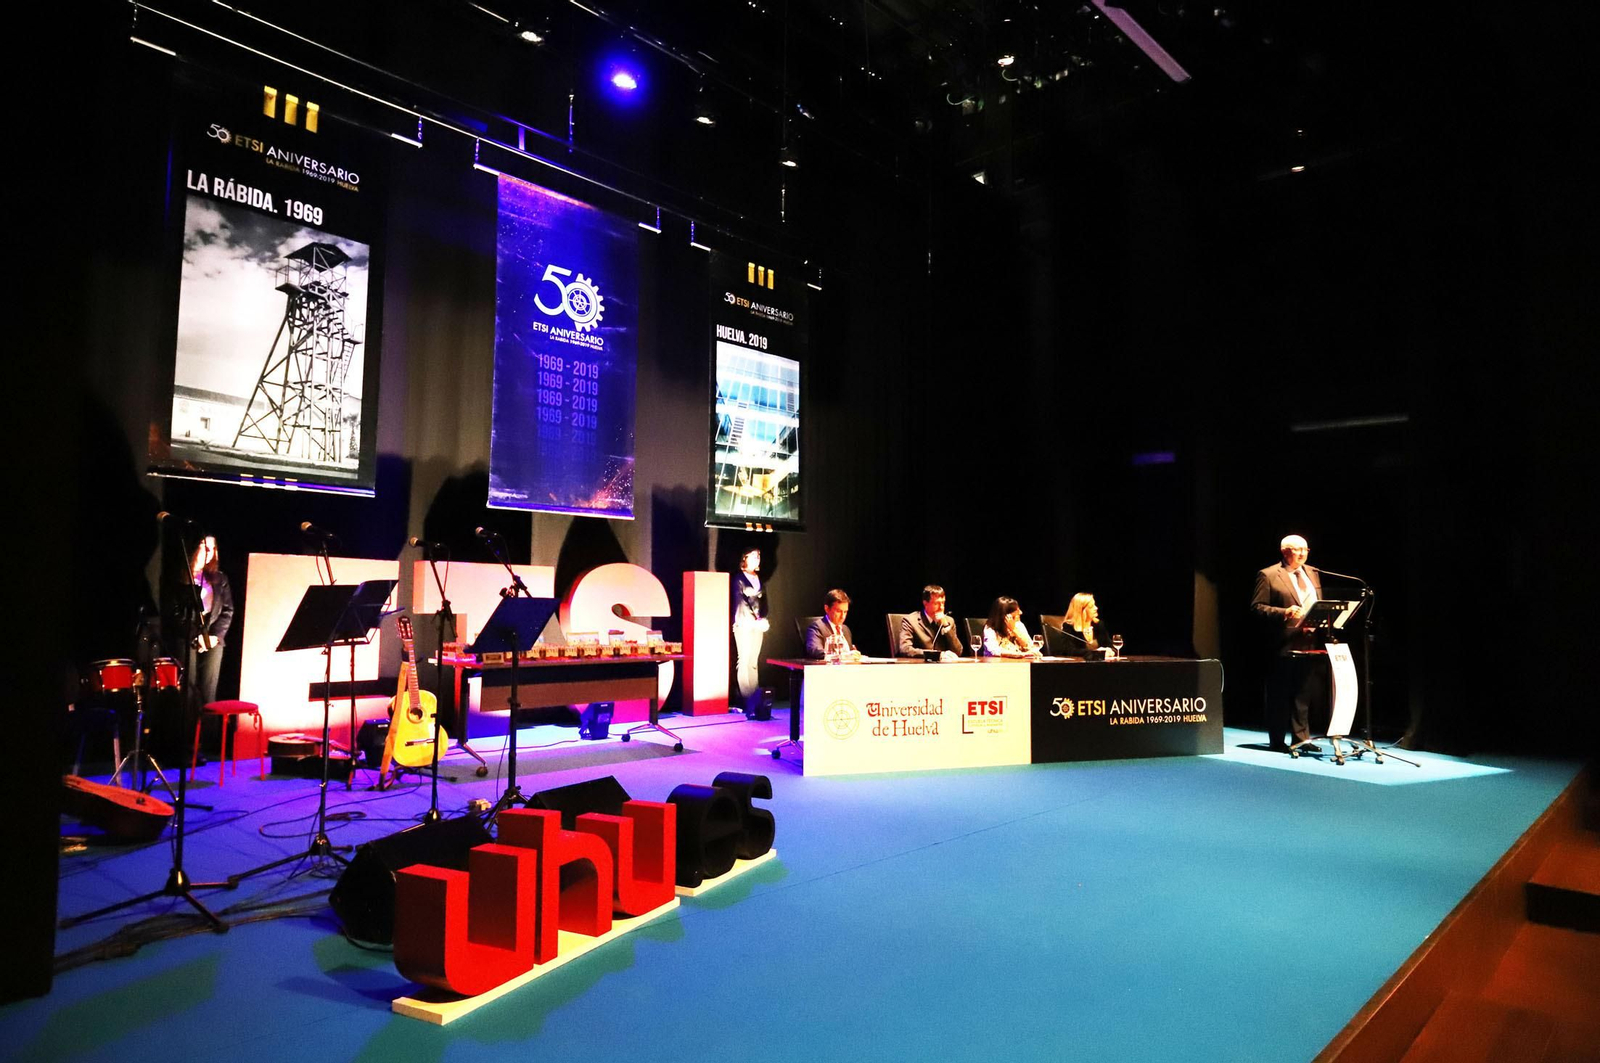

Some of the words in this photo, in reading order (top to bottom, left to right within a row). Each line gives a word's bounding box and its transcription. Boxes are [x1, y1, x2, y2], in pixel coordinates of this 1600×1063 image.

[235, 134, 264, 153] ETSI
[266, 146, 360, 184] ANIVERSARIO
[186, 169, 209, 193] LA
[213, 177, 278, 214] RÁBIDA.
[284, 199, 323, 225] 1969
[337, 180, 359, 192] HUELVA
[534, 264, 605, 332] 50
[736, 297, 750, 308] ETSI
[750, 302, 794, 321] ANIVERSARIO
[533, 321, 549, 333] ETSI
[550, 326, 604, 346] ANIVERSARIO
[716, 324, 747, 344] HUELVA.
[748, 333, 768, 350] 2019
[539, 353, 563, 372] 1969
[573, 360, 599, 379] 2019
[537, 371, 563, 389] 1969
[572, 378, 598, 396] 2019
[536, 388, 562, 407] 1969
[572, 394, 598, 413] 2019
[536, 406, 562, 424] 1969
[571, 412, 597, 430] 2019
[233, 552, 730, 759] ETSI
[865, 698, 943, 717] Universidad
[967, 700, 1003, 716] ETSI
[1077, 700, 1105, 716] ETSI
[1109, 697, 1207, 715] ANIVERSARIO
[872, 719, 889, 737] de
[892, 719, 939, 737] Huelva
[1109, 717, 1118, 725] LA
[1120, 716, 1144, 725] RABIDA
[1146, 715, 1181, 724] 1969-2019
[1183, 714, 1207, 723] HUELVA
